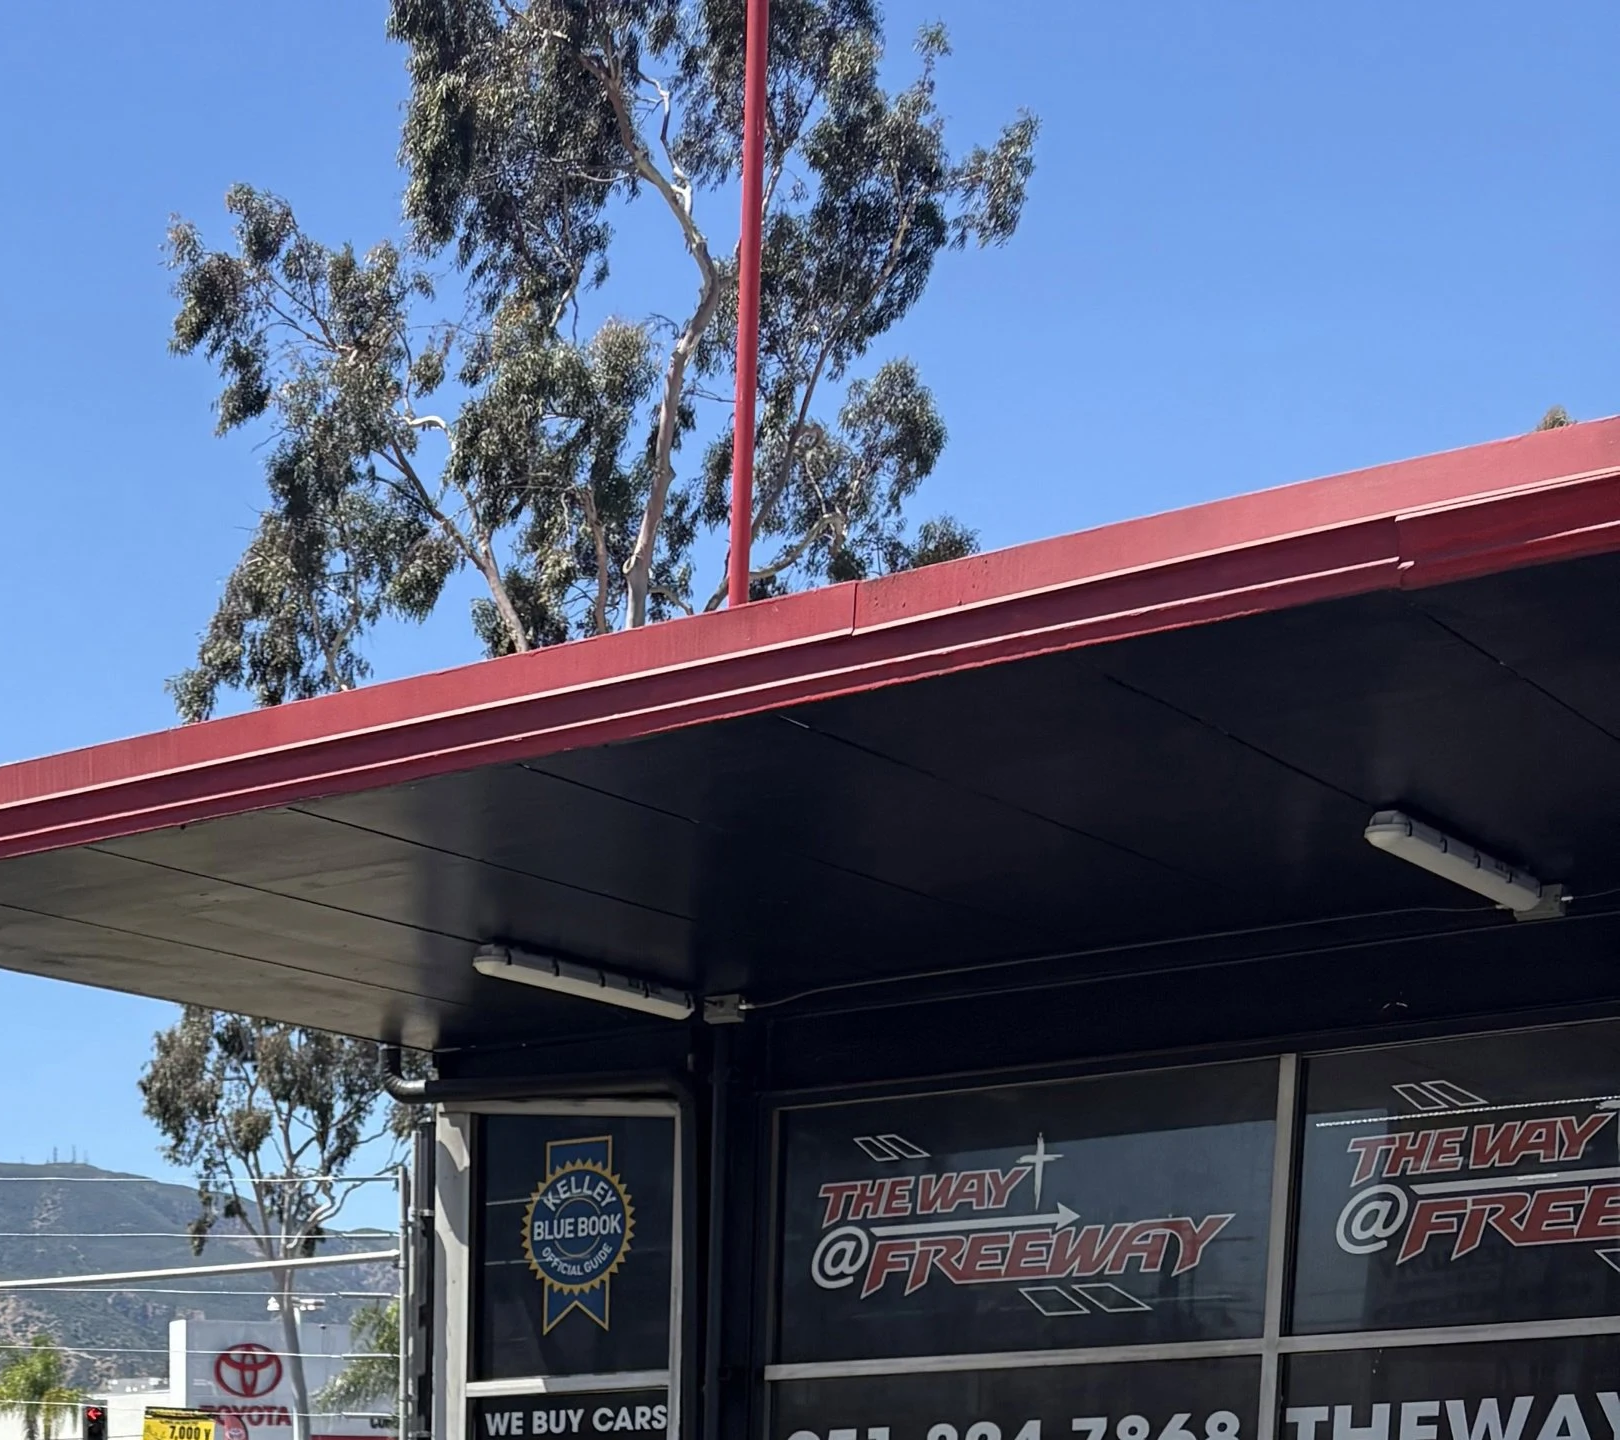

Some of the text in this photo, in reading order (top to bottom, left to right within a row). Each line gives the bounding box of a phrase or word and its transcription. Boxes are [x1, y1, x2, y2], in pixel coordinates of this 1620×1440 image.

[1347, 1112, 1616, 1188] THE WAY
[543, 1175, 617, 1212] KELLEY
[818, 1165, 1033, 1229] THE WAY
[533, 1212, 622, 1241] BLUE BOOK
[541, 1242, 613, 1276] OFFICIAL GUIDE
[485, 1404, 668, 1436] WE BUY CARS
